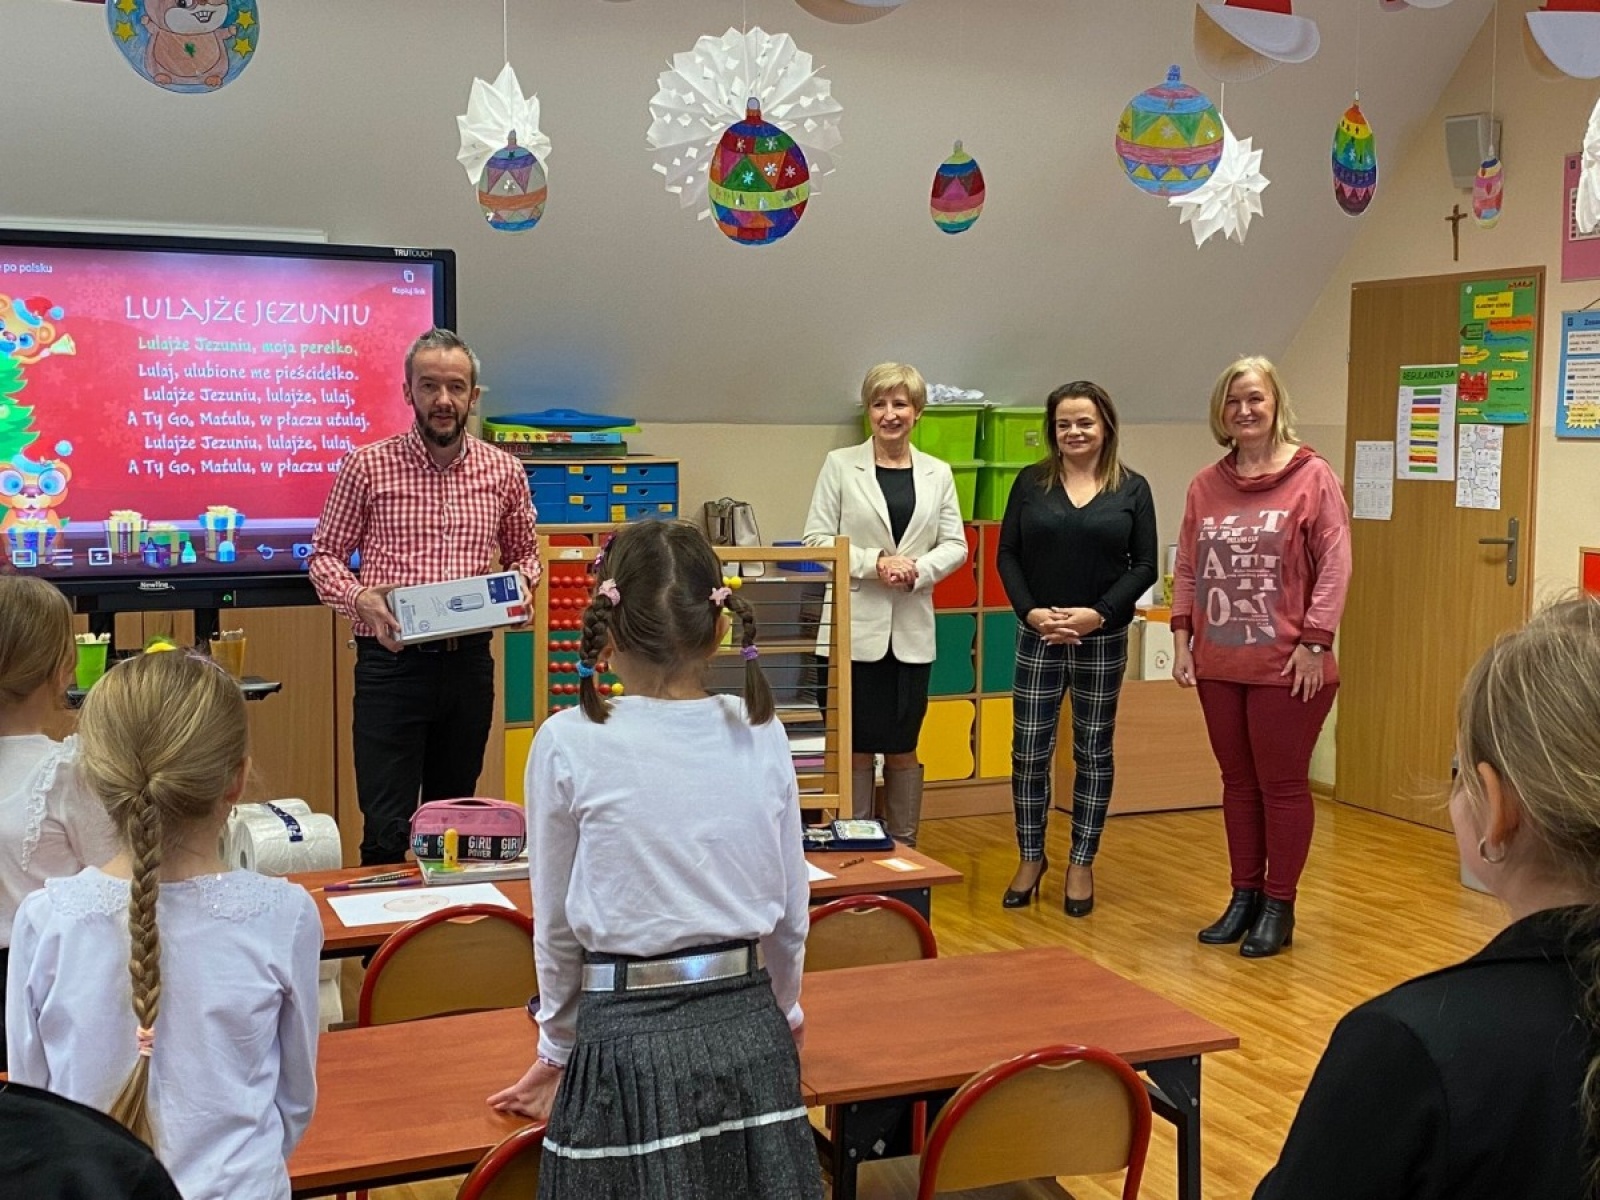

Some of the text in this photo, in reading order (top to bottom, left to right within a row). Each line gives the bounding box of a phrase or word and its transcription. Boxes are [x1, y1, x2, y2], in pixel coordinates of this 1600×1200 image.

[394, 248, 433, 258] TRUTOUCH
[3, 262, 53, 274] po polsku
[125, 296, 371, 326] LULAJŻE JEZUNIU
[138, 336, 190, 357] Lulajże
[195, 336, 257, 354] Jezuniu,
[262, 338, 296, 359] moja
[138, 361, 360, 384] Lulaj, ulubione me pieścidełko.
[144, 386, 356, 409] Lulajże Jezuniu, lulajże, lulaj,
[127, 411, 138, 426] A
[142, 411, 163, 430] Ty
[200, 411, 256, 428] Matulu,
[260, 415, 272, 426] w
[277, 411, 323, 430] płaczu
[326, 411, 370, 432] utulaj.
[144, 433, 197, 456] Lulajże
[200, 434, 262, 452] Jezuniu,
[267, 434, 318, 456] lulajże,
[128, 459, 139, 474] A
[143, 459, 164, 479] Ty
[168, 459, 196, 476] Go,
[200, 459, 256, 476] Matulu,
[260, 463, 273, 474] w
[277, 458, 323, 478] płaczu
[467, 835, 492, 850] GIRL
[467, 848, 492, 858] POWER
[501, 837, 518, 850] GIR
